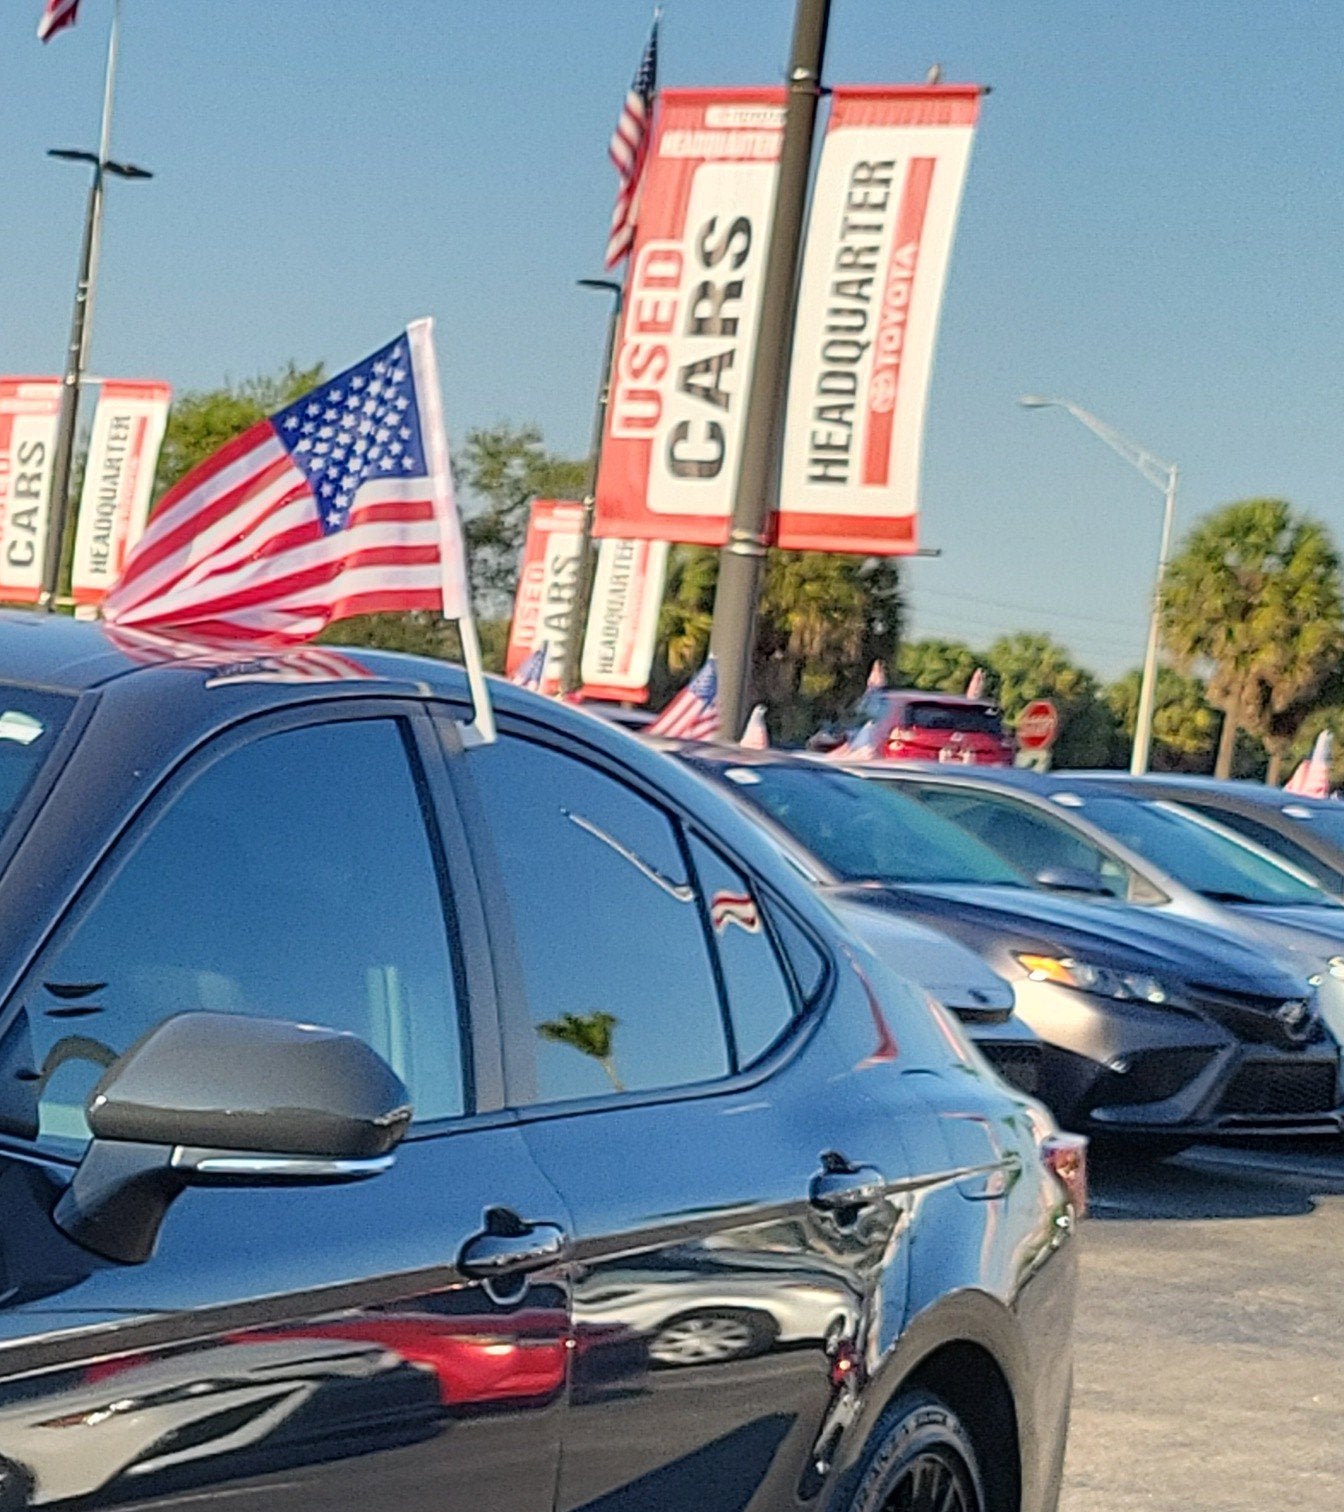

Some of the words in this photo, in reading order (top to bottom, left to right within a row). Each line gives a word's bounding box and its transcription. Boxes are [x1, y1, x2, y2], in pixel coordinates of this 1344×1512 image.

[621, 248, 683, 432] USED
[665, 214, 753, 482] CARS
[805, 156, 896, 486] HEADQUARTER
[875, 243, 916, 366] TOYOTA
[7, 440, 46, 568] CARS
[89, 414, 132, 575] HEADQUARTER
